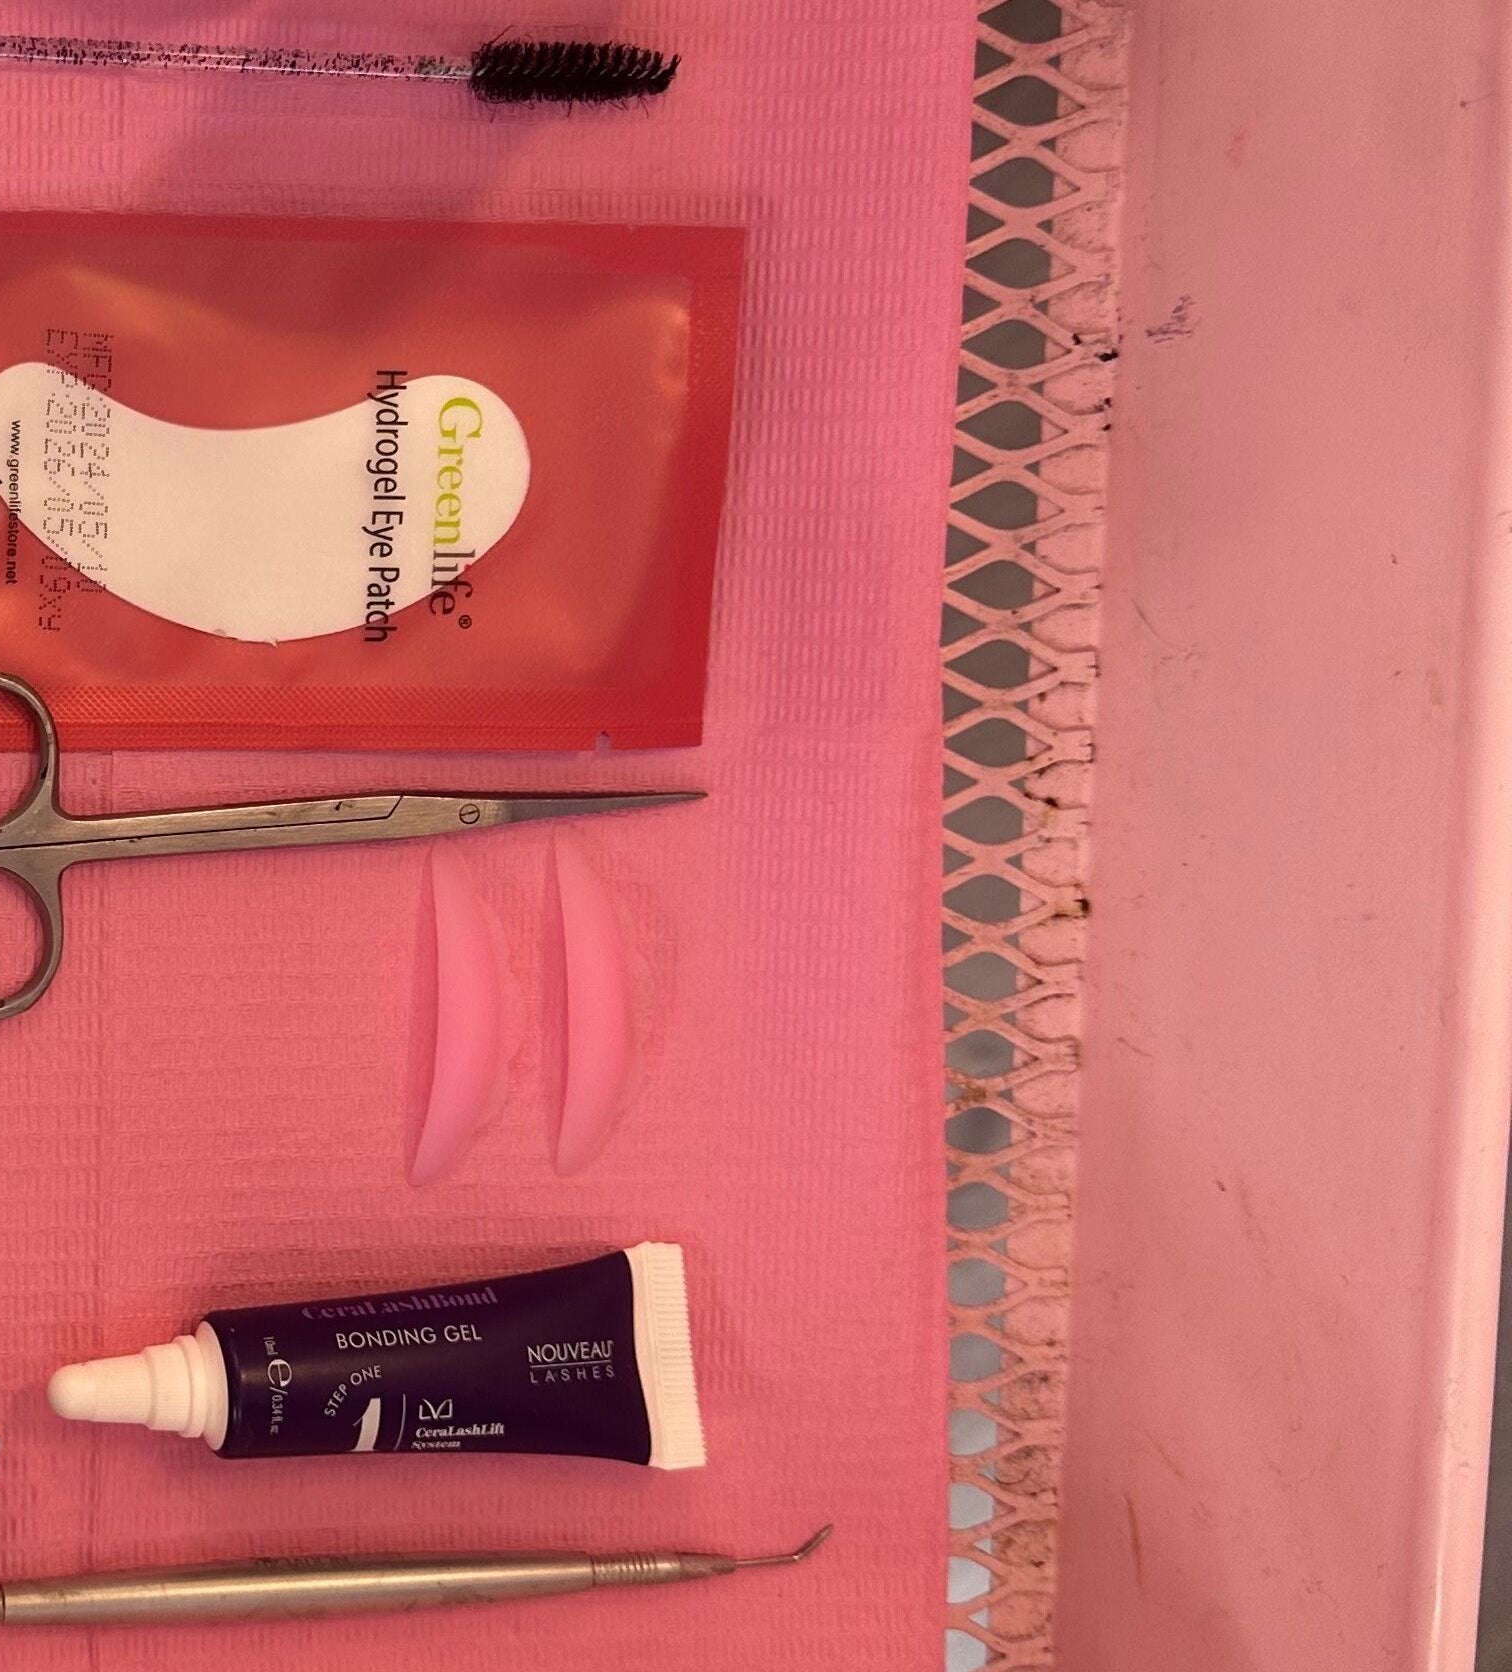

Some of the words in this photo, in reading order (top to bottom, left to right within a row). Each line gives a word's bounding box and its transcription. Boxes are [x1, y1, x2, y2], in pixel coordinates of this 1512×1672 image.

[365, 370, 409, 500] Hydrogel
[5, 419, 23, 585] www.greenlifestore.net
[428, 396, 483, 616] Greenlife
[361, 510, 404, 558] Eye
[364, 566, 401, 643] Patch
[300, 1285, 499, 1321] CeraLashBond
[335, 1326, 437, 1351] BONDING
[443, 1323, 483, 1344] GEL
[323, 1384, 348, 1417] STEP
[349, 1364, 383, 1387] ONE
[529, 1364, 617, 1384] LASHES
[351, 1397, 382, 1452] 1
[414, 1422, 506, 1439] CeraLashLift
